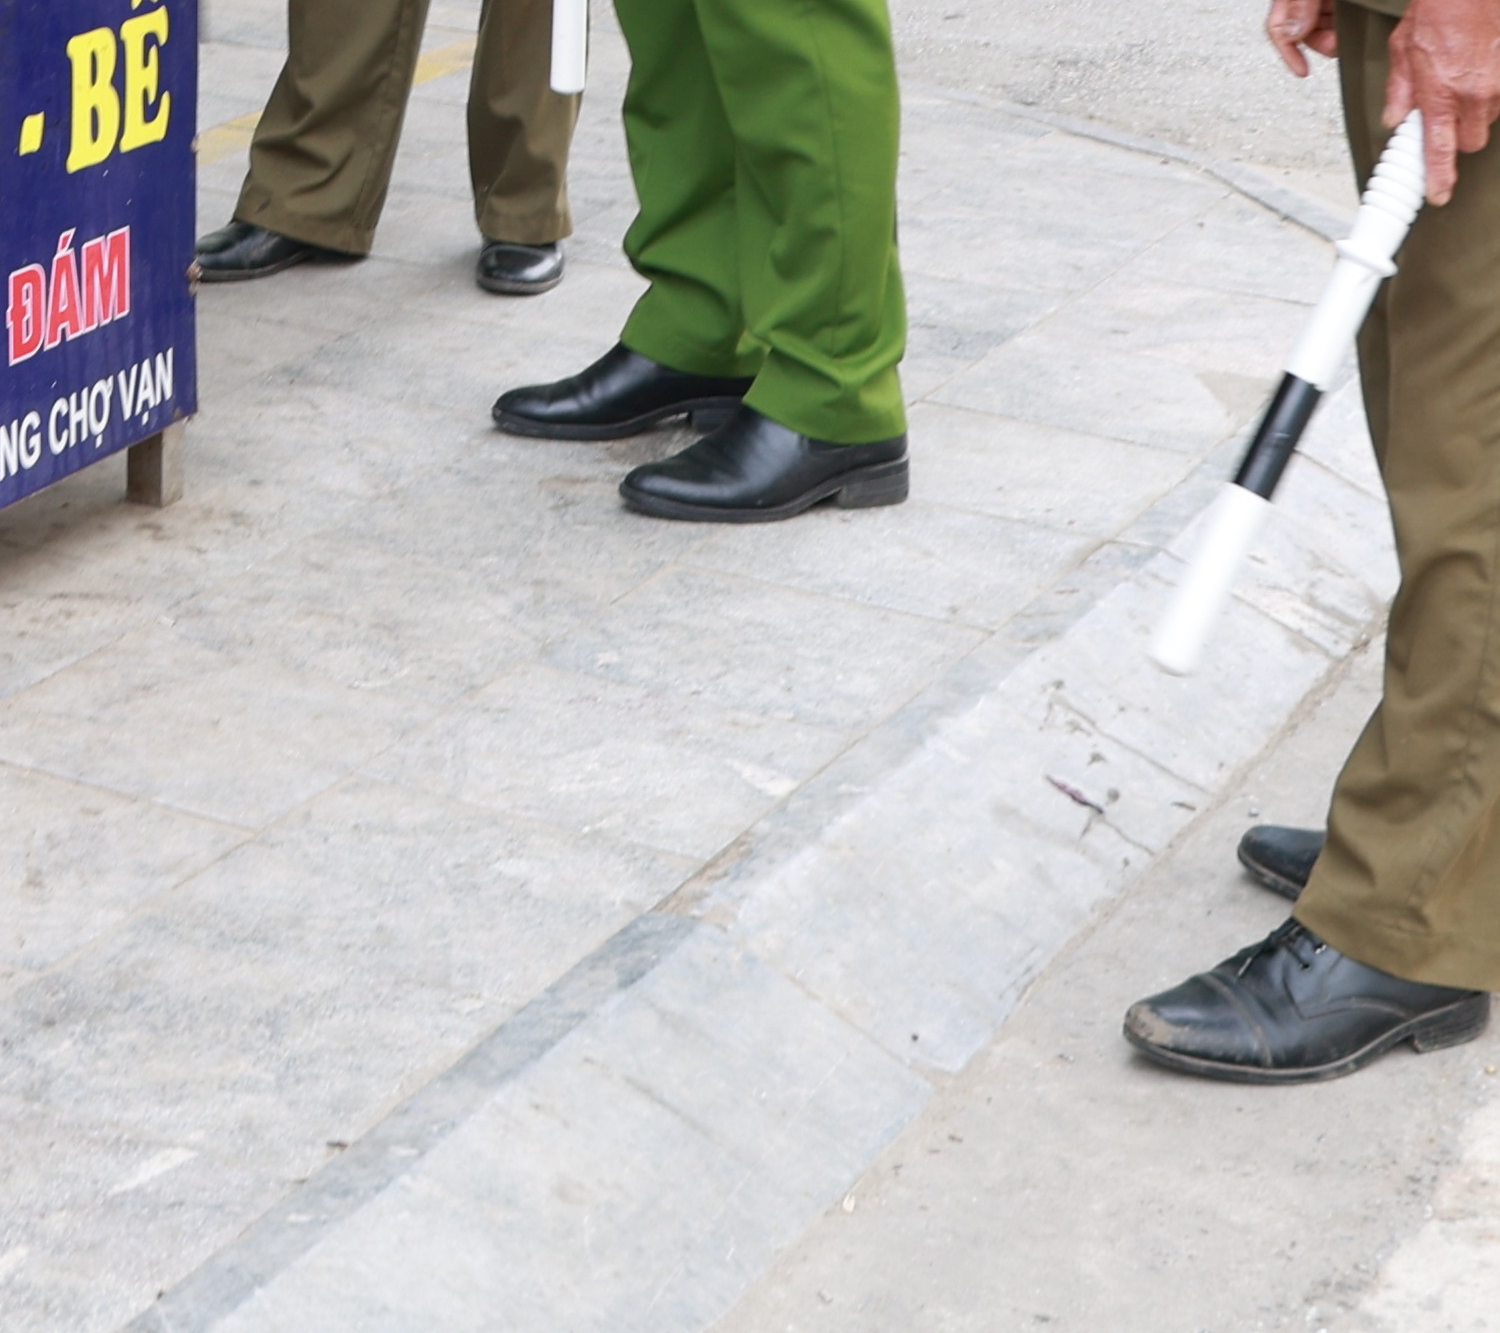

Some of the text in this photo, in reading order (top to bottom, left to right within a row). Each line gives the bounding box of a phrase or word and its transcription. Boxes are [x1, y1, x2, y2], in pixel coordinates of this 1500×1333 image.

[6, 225, 131, 367] ĐÁM
[47, 373, 117, 450] CHỢ
[117, 347, 175, 426] VẠN
